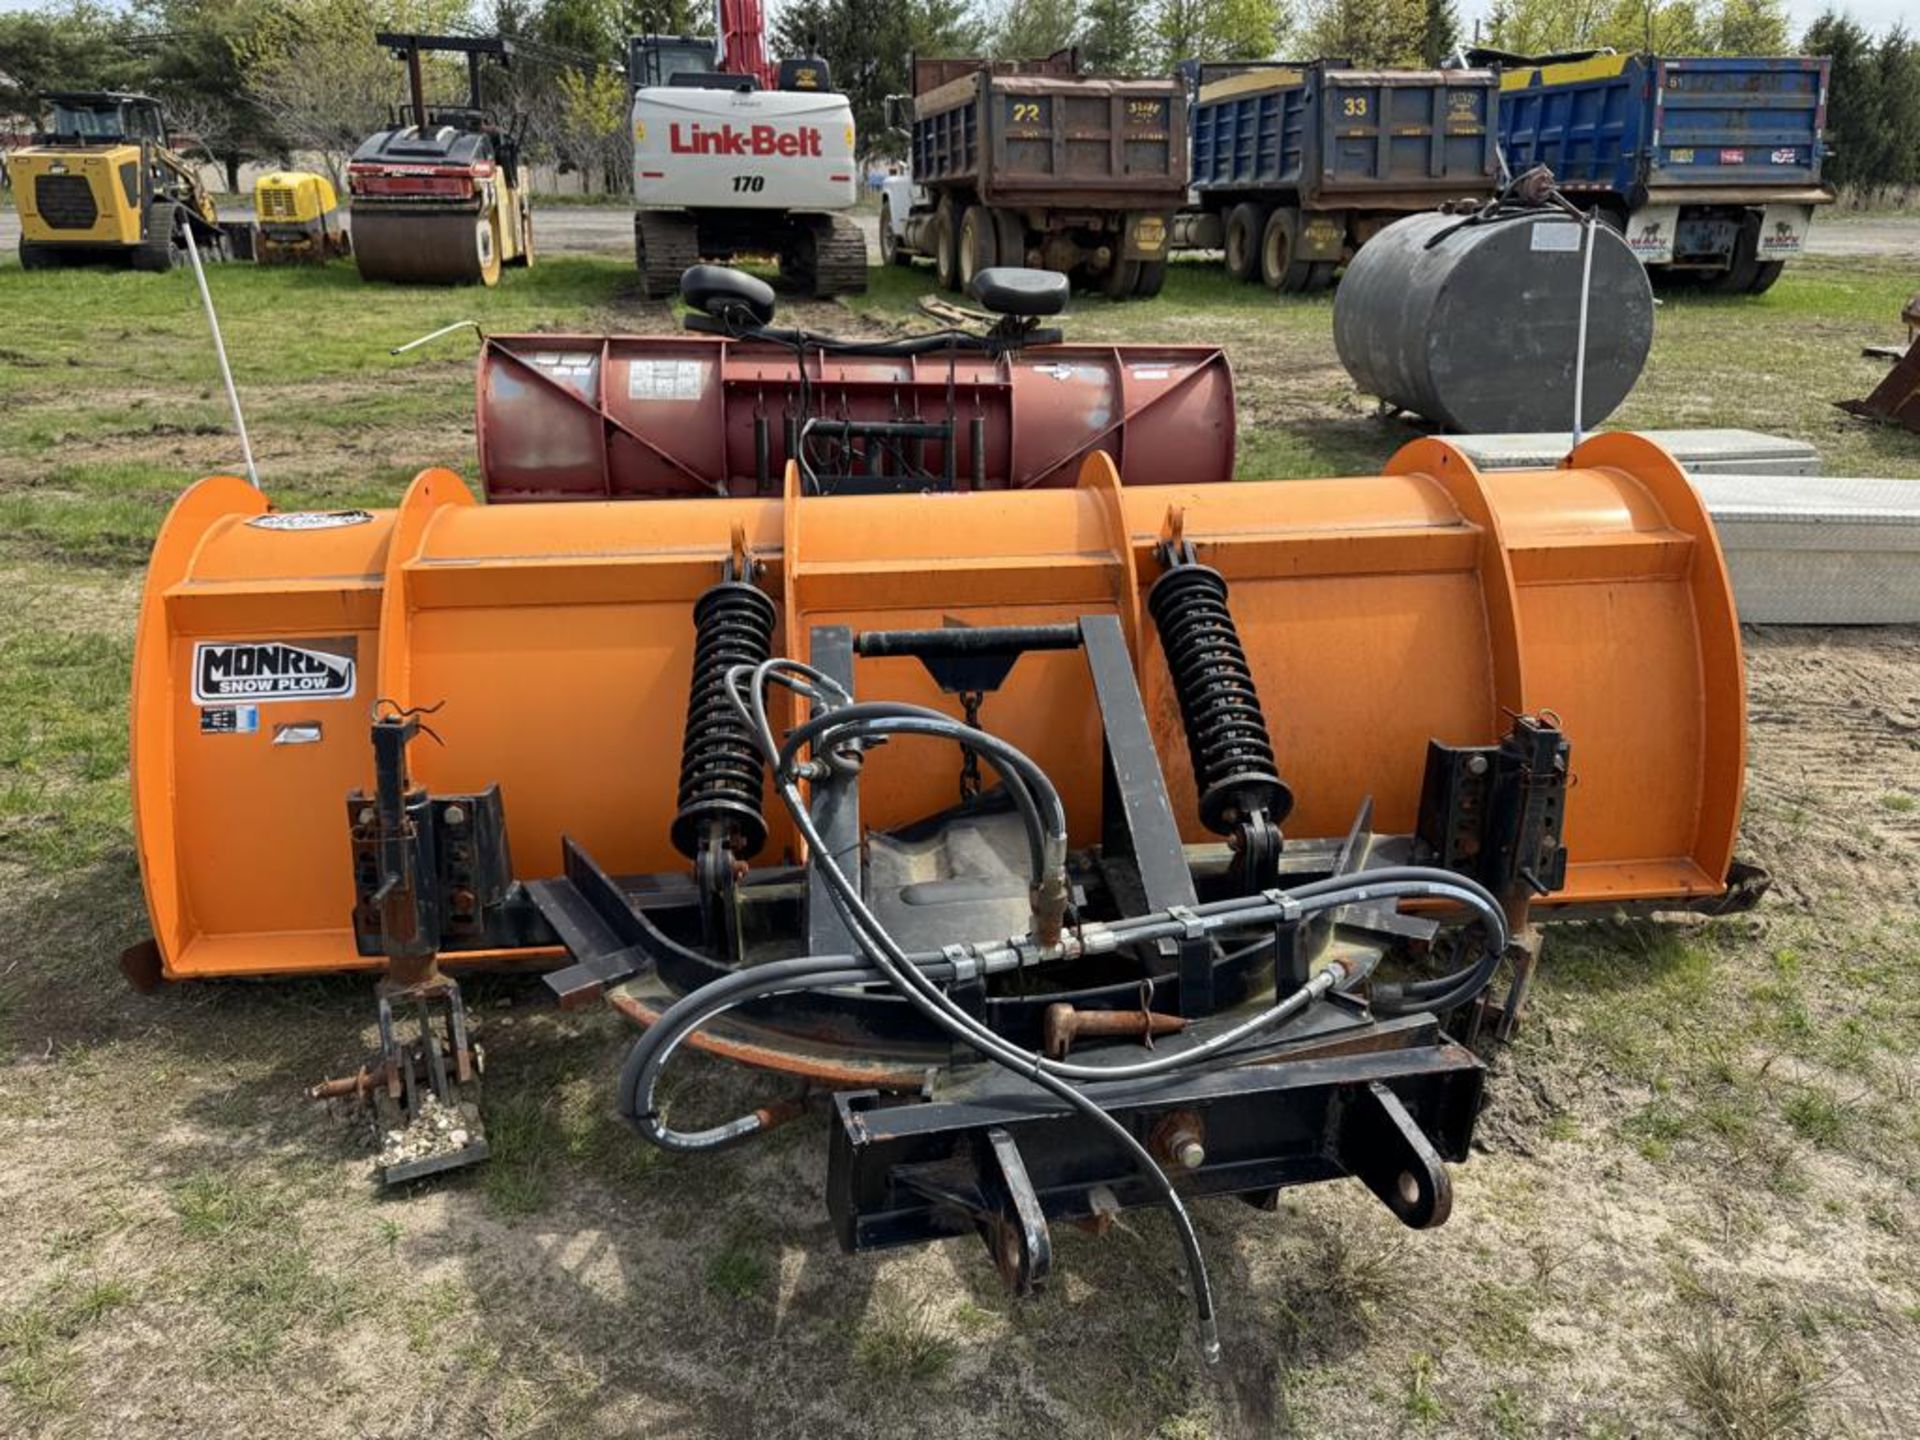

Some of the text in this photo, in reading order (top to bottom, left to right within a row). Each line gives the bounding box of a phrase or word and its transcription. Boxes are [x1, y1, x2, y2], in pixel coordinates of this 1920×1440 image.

[1343, 97, 1367, 116] 33
[670, 123, 822, 157] Link-Belt
[732, 176, 765, 192] 170
[219, 677, 329, 693] SNOW PLOW
